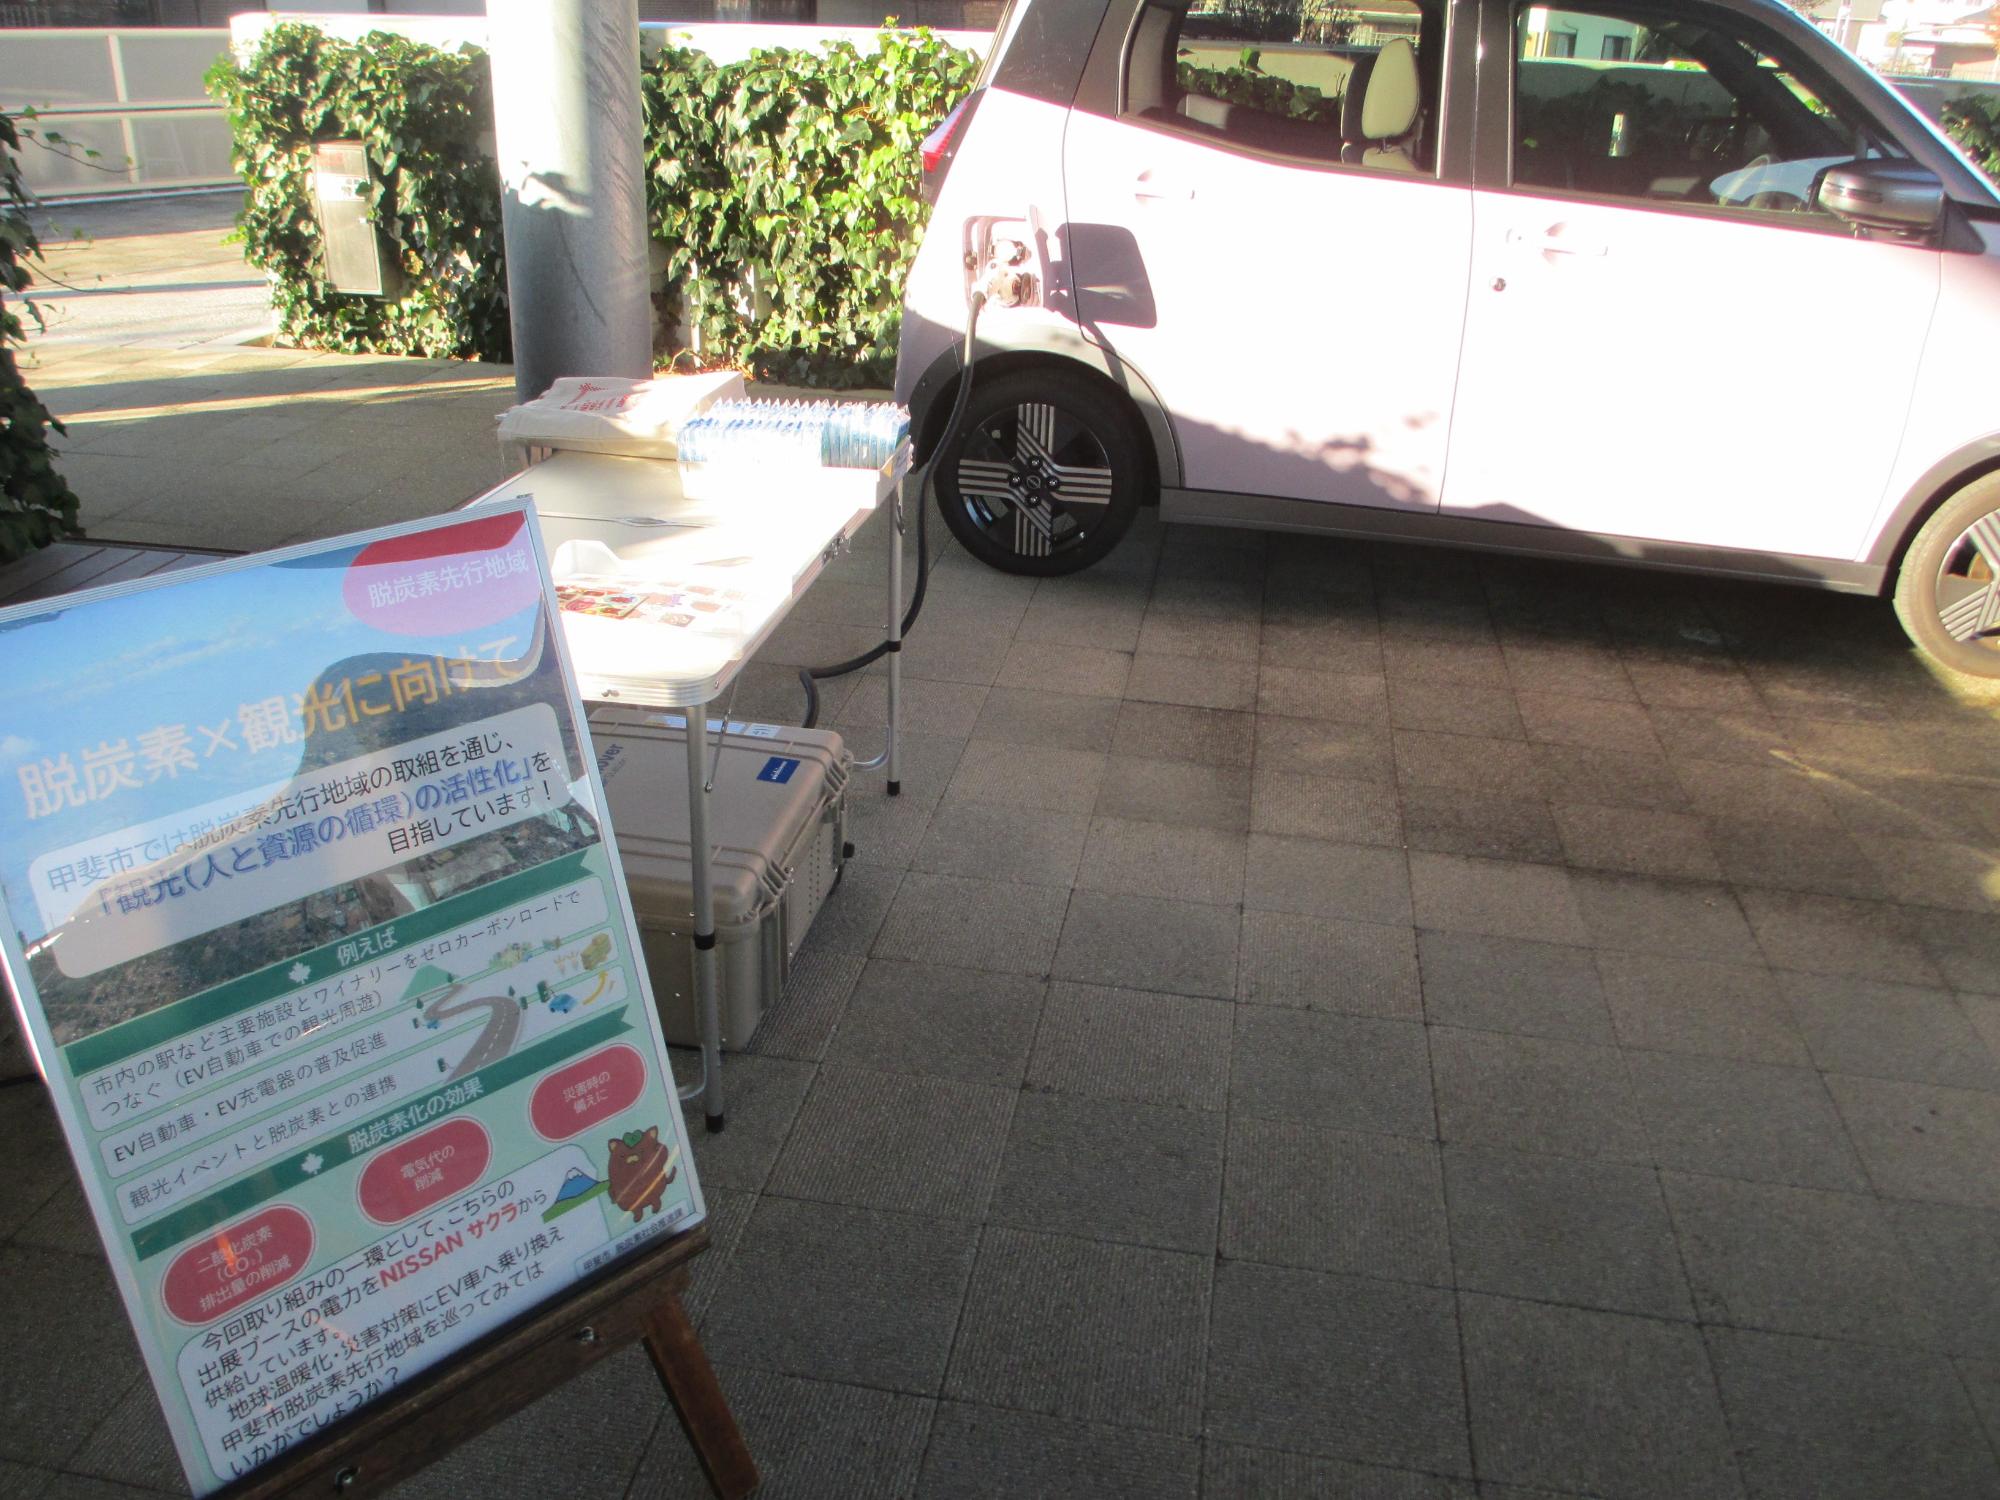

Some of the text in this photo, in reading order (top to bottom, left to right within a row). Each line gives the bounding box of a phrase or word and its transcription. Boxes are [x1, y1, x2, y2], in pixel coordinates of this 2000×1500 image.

[368, 551, 529, 608] 脱炭素先行地域
[17, 635, 518, 820] 脱炭素×観光に向けて
[47, 731, 514, 894] 甲斐市では脱炭素先行地域の取組を通じ、
[92, 889, 581, 1096] 市内の駅など主要施設とワイナリーをゼロカーボンロードで
[336, 925, 399, 968] 例えば
[114, 1031, 388, 1163] EV自動車・EV充電器の普及促進
[128, 1075, 398, 1210] 観光イベントと脱炭素との連携
[347, 1076, 484, 1156] 脱炭素化の効果
[400, 1144, 456, 1181] 電気代の
[414, 1168, 446, 1193] 削減
[199, 1253, 293, 1314] 排出量の削減
[201, 1179, 515, 1352] 今回取り組みの一環として、こちらの
[205, 1326, 341, 1409] 供給しています。
[221, 1260, 545, 1453] 甲斐市脱炭素先行地域を巡ってみては
